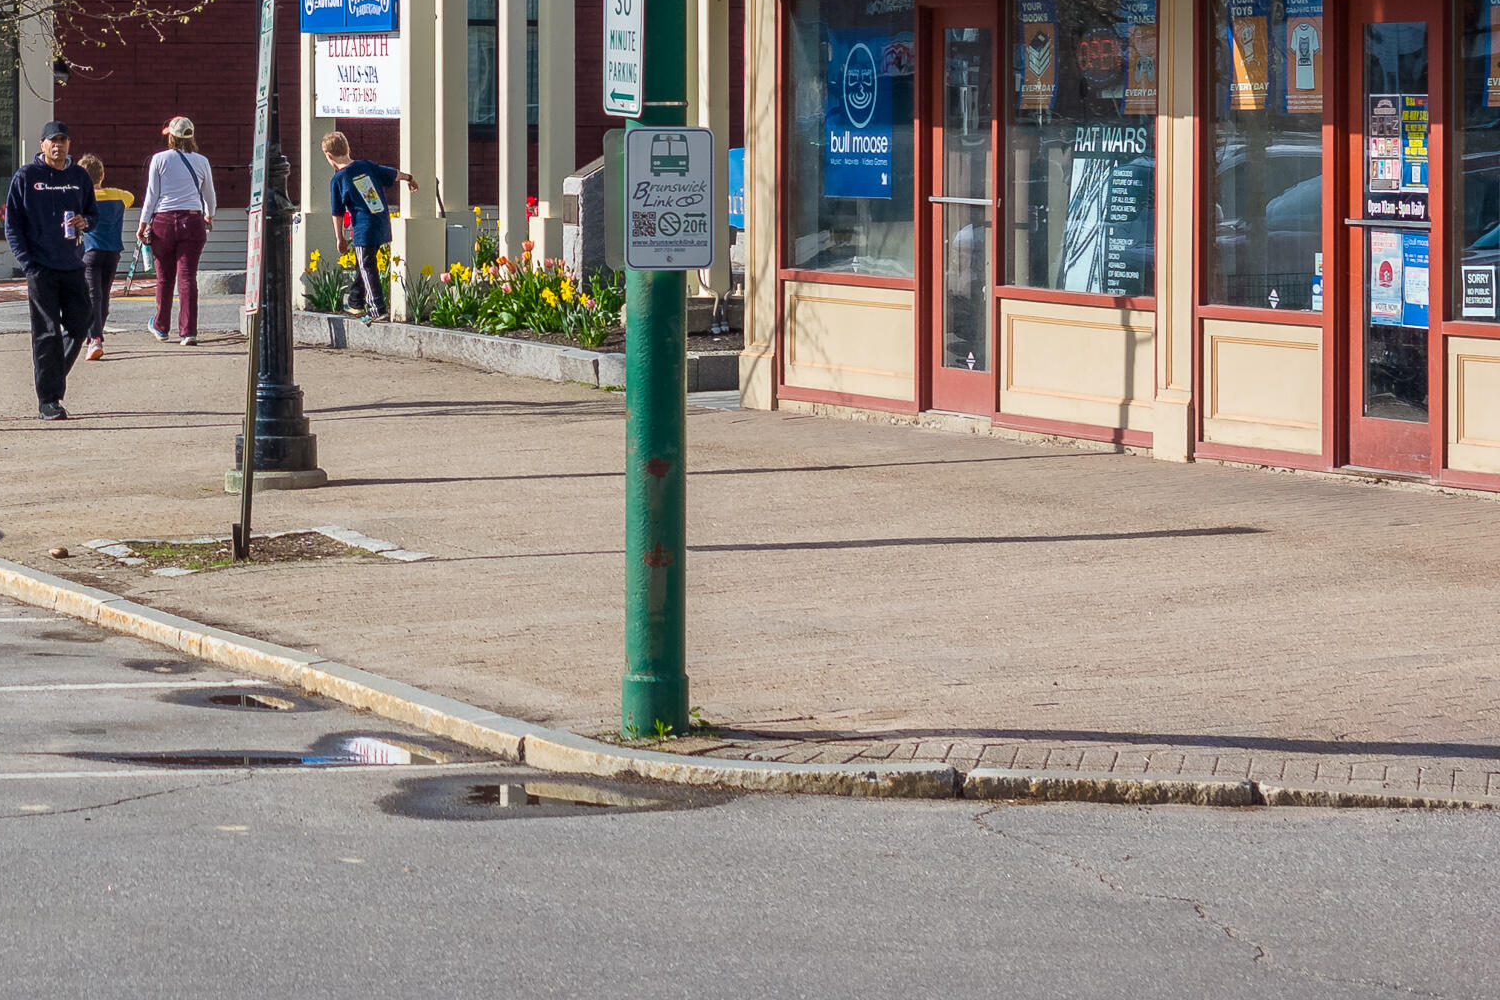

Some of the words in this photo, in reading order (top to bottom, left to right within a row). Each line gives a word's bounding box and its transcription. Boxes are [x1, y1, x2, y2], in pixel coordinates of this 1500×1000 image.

[1021, 1, 1043, 12] YOUR
[1231, 6, 1254, 16] TOYS
[327, 33, 390, 58] ELIZABETH
[609, 29, 636, 52] MINUTE
[608, 61, 638, 84] PARKING
[1147, 88, 1157, 97] DA
[830, 130, 850, 153] bull
[852, 134, 889, 154] moose
[1074, 127, 1100, 152] RAT
[1101, 127, 1148, 154] WARS
[33, 182, 81, 192] Champion
[632, 180, 708, 200] Brunswick
[643, 193, 675, 208] Link
[1367, 199, 1382, 217] Open
[1410, 201, 1426, 220] Daily
[682, 219, 708, 234] 20ft
[1467, 273, 1490, 284] SORRY
[1474, 287, 1491, 296] PUBLIC
